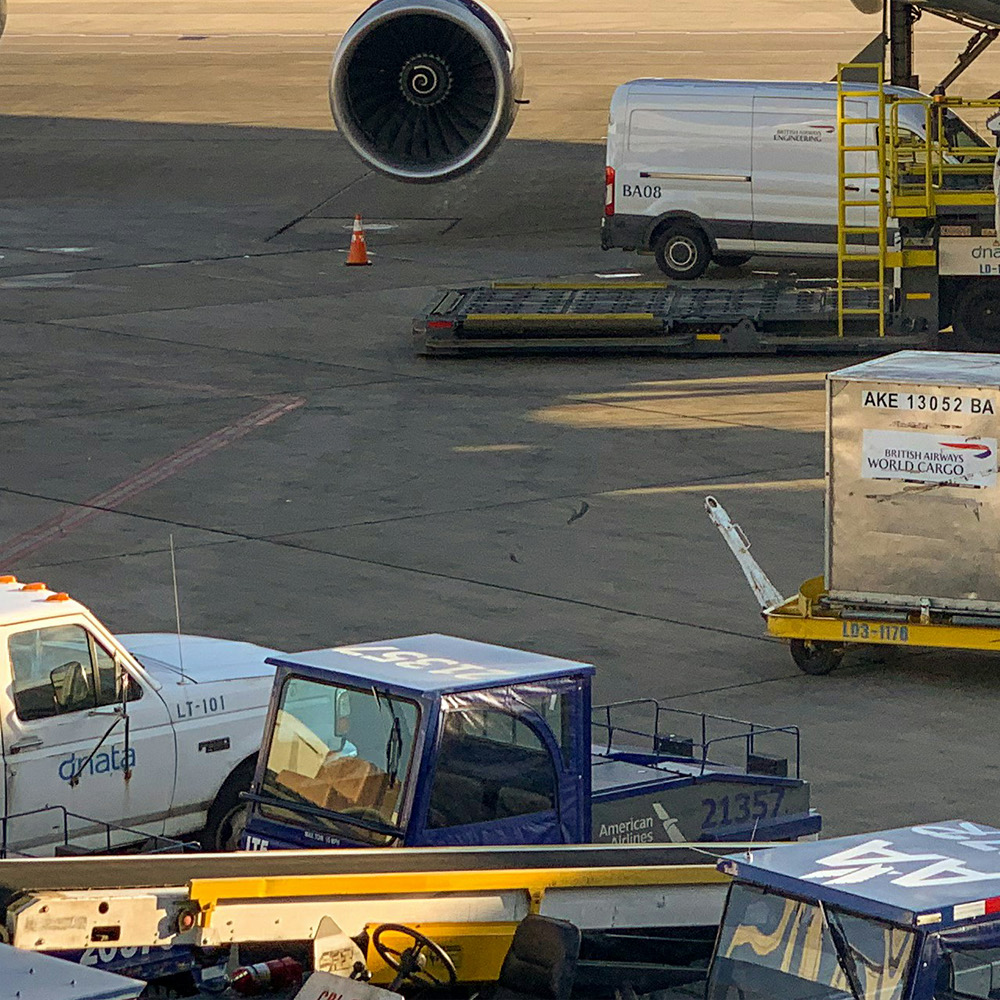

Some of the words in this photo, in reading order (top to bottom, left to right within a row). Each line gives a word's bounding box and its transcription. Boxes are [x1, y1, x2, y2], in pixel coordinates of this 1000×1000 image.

[773, 134, 822, 142] ENGINEERING
[623, 184, 661, 198] BA08
[864, 391, 898, 408] AKE
[907, 394, 962, 412] 13052
[970, 398, 994, 415] BA
[867, 457, 914, 473] WORLD
[917, 461, 964, 476] CARGO
[885, 448, 922, 460] BRITISH
[924, 451, 964, 463] AIRWAYS
[330, 646, 517, 680] 21357
[177, 695, 225, 718] LT-101
[59, 745, 136, 780] dnata
[701, 788, 785, 829] 21357
[599, 816, 653, 837] American
